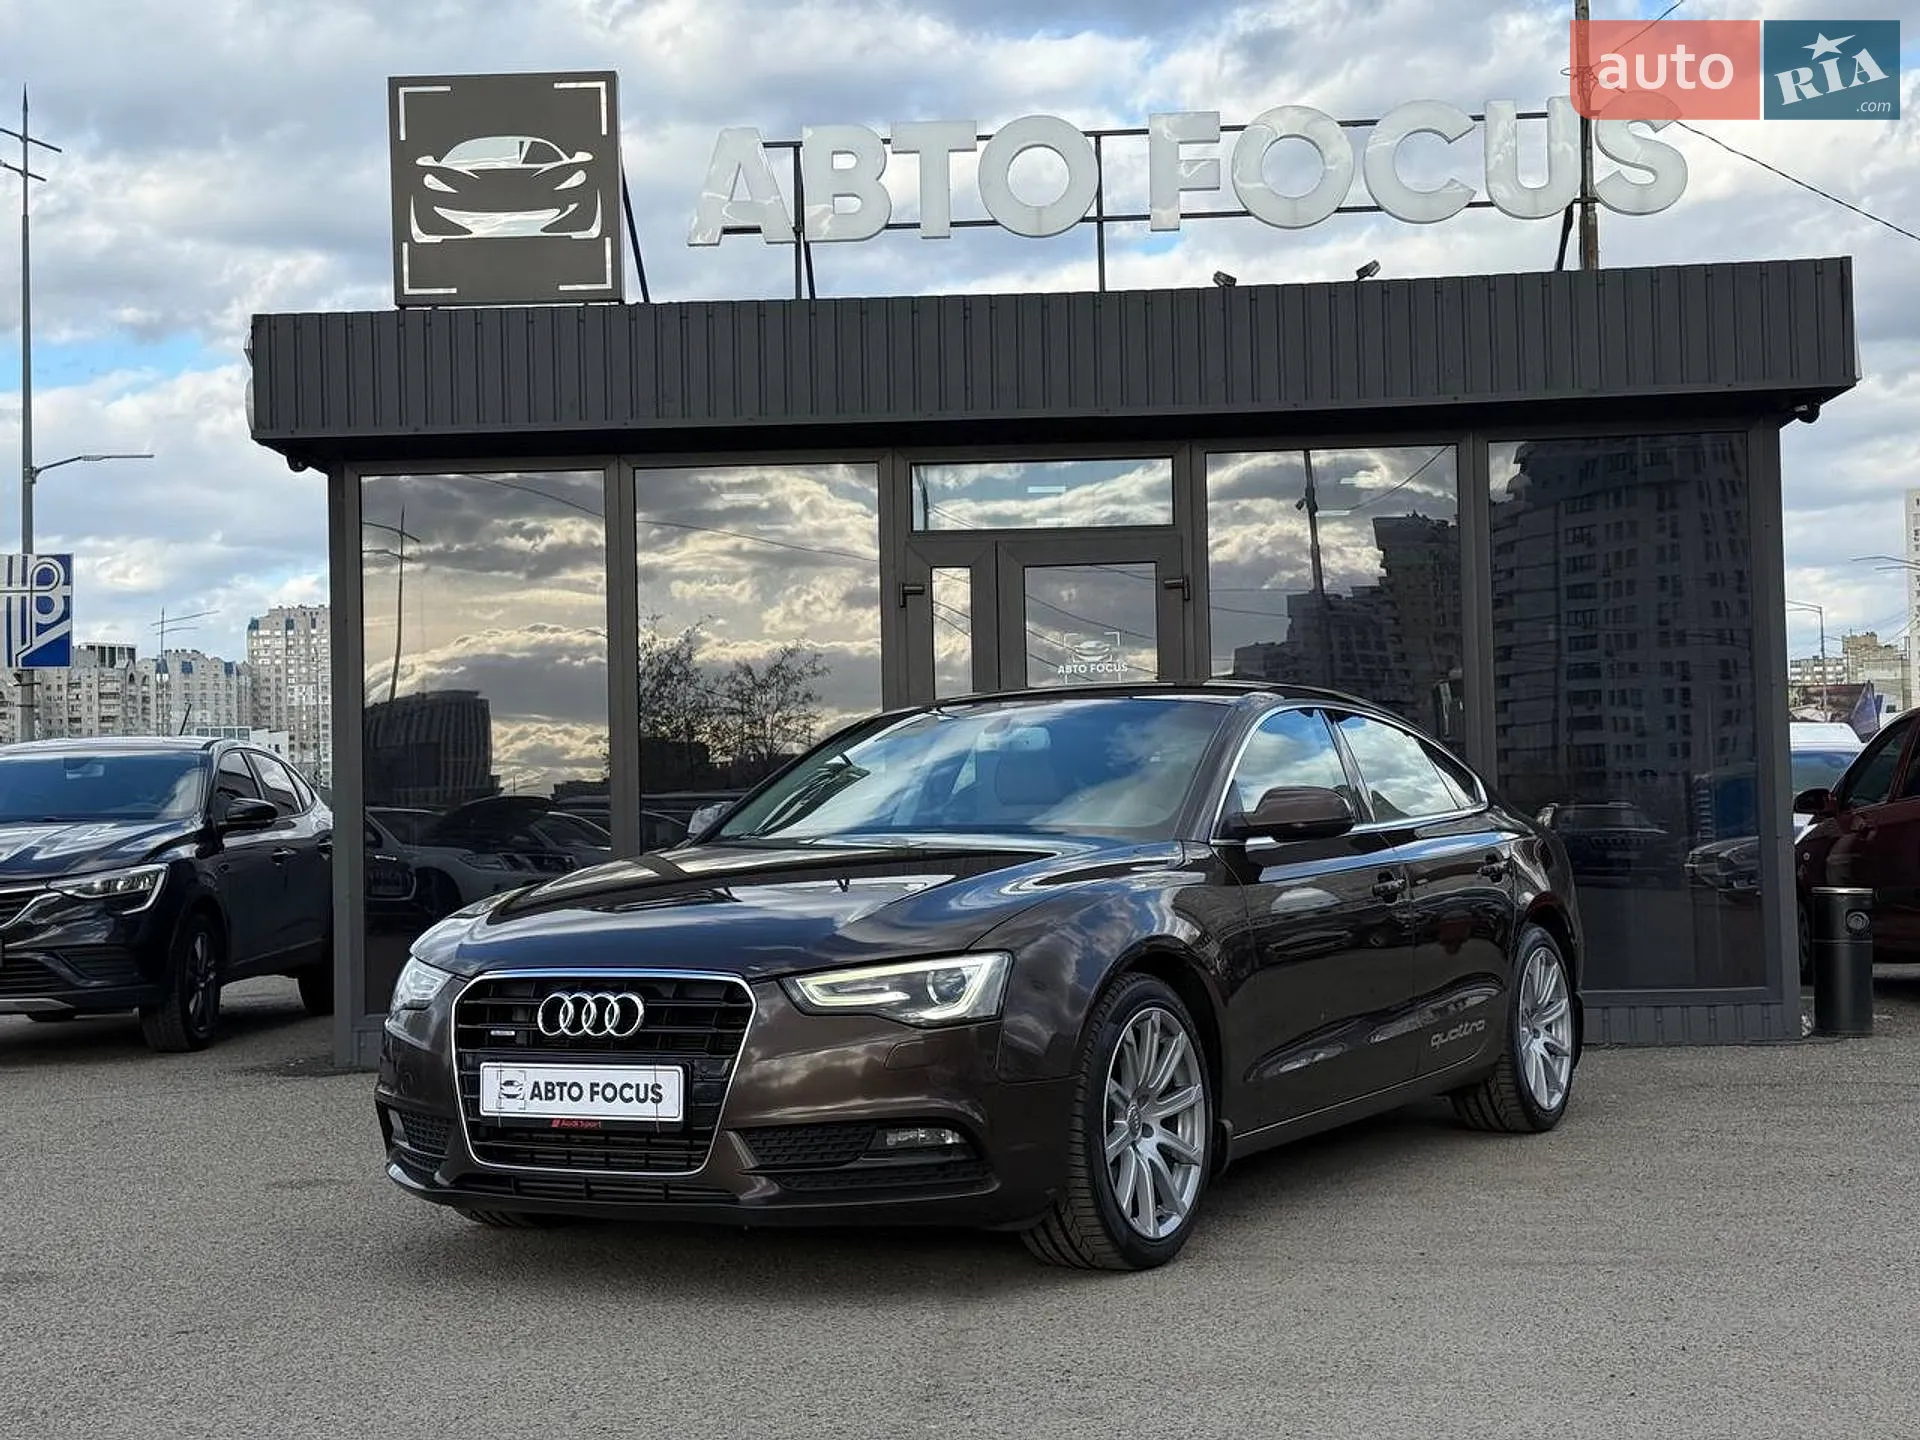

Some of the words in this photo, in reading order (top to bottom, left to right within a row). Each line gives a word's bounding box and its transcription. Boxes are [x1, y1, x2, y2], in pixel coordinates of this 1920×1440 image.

[687, 114, 1100, 247] АВТО
[1148, 90, 1689, 233] FOCUS
[1057, 664, 1088, 675] АВТО
[1090, 661, 1129, 674] FOCUS
[529, 1080, 584, 1103] АВТО
[589, 1081, 664, 1104] FOCUS
